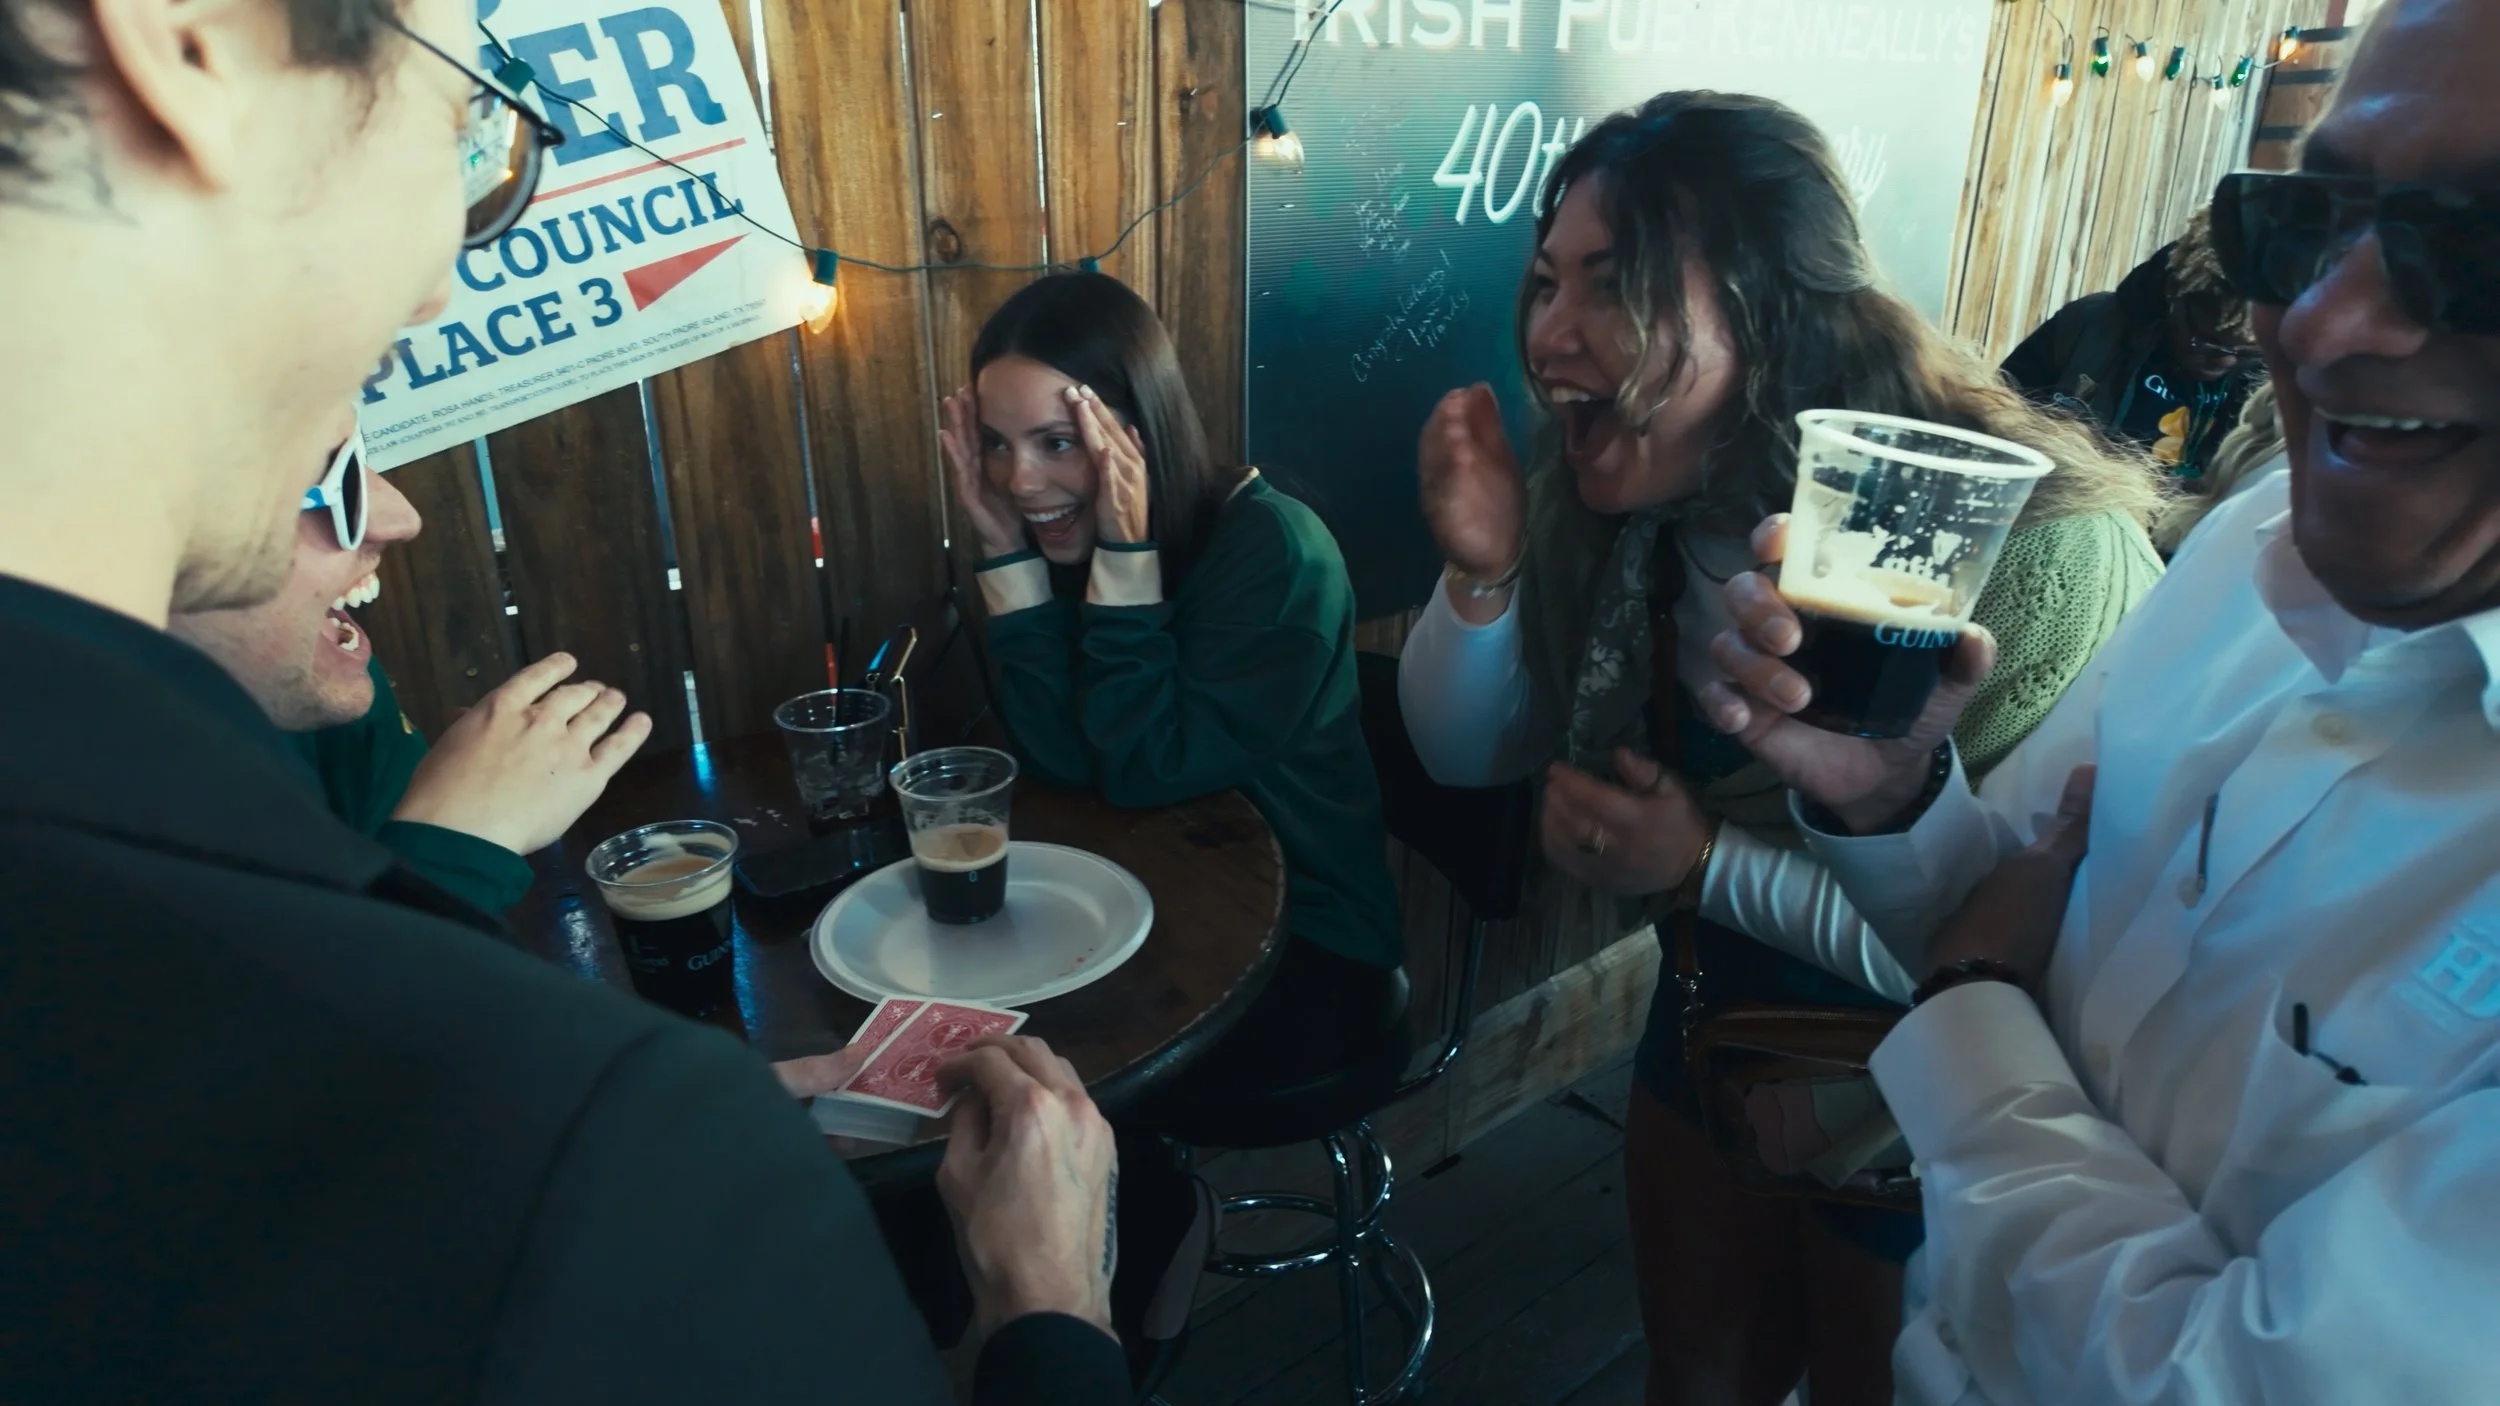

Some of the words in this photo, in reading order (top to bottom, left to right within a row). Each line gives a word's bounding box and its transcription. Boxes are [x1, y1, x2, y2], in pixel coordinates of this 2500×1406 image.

[480, 5, 728, 168] ER
[1293, 0, 1521, 48] IRISH
[455, 171, 744, 292] COUNCIL
[361, 290, 578, 406] PLACE
[578, 277, 623, 328] 3
